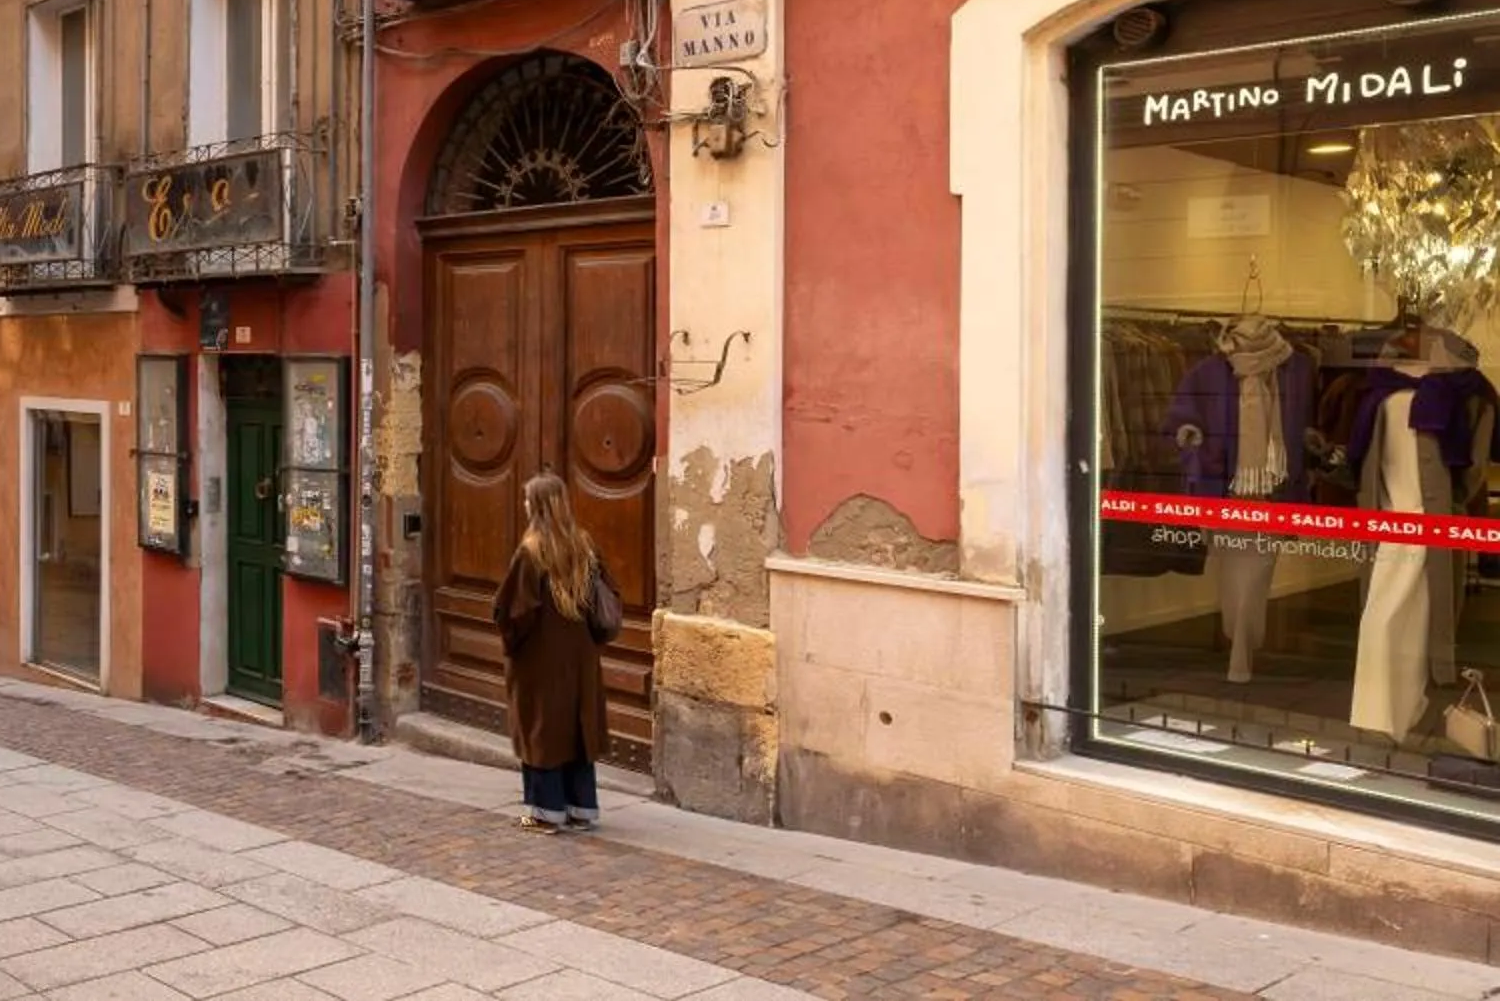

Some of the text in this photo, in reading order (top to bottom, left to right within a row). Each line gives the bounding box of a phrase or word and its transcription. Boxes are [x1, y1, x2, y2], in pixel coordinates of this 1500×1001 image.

[701, 11, 736, 28] VIA
[683, 31, 755, 56] MANNO
[1144, 86, 1279, 125] MARTINO
[1101, 500, 1500, 542] ALDI SALDI SALDI SALDI SALDI SALD
